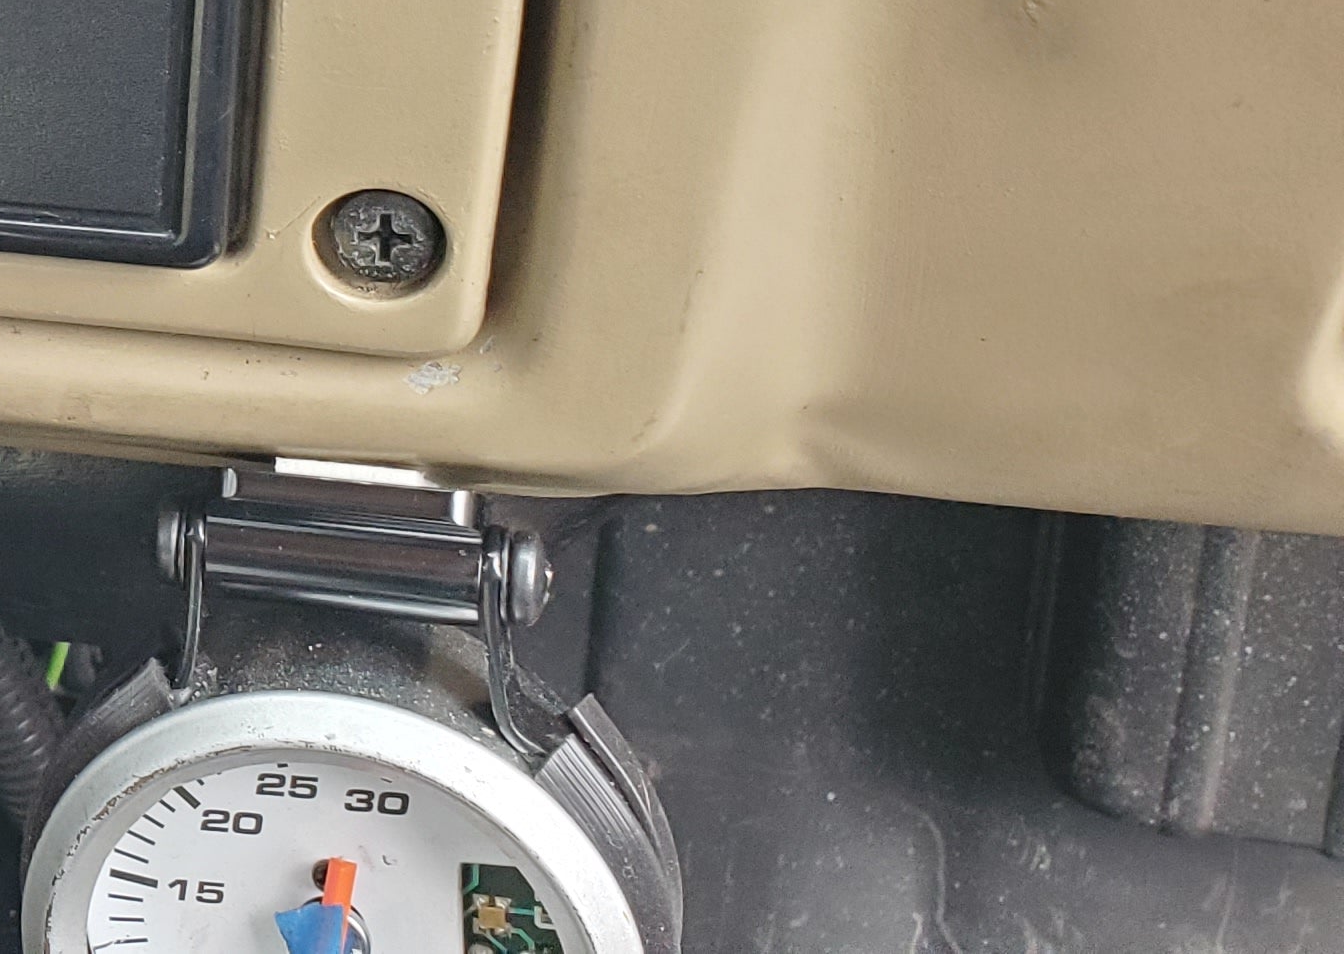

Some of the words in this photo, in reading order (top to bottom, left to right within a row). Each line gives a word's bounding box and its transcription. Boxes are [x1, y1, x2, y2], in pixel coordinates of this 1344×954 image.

[255, 772, 319, 800] 25
[344, 788, 410, 816] 30
[200, 809, 264, 836] 20
[168, 879, 225, 904] 15
